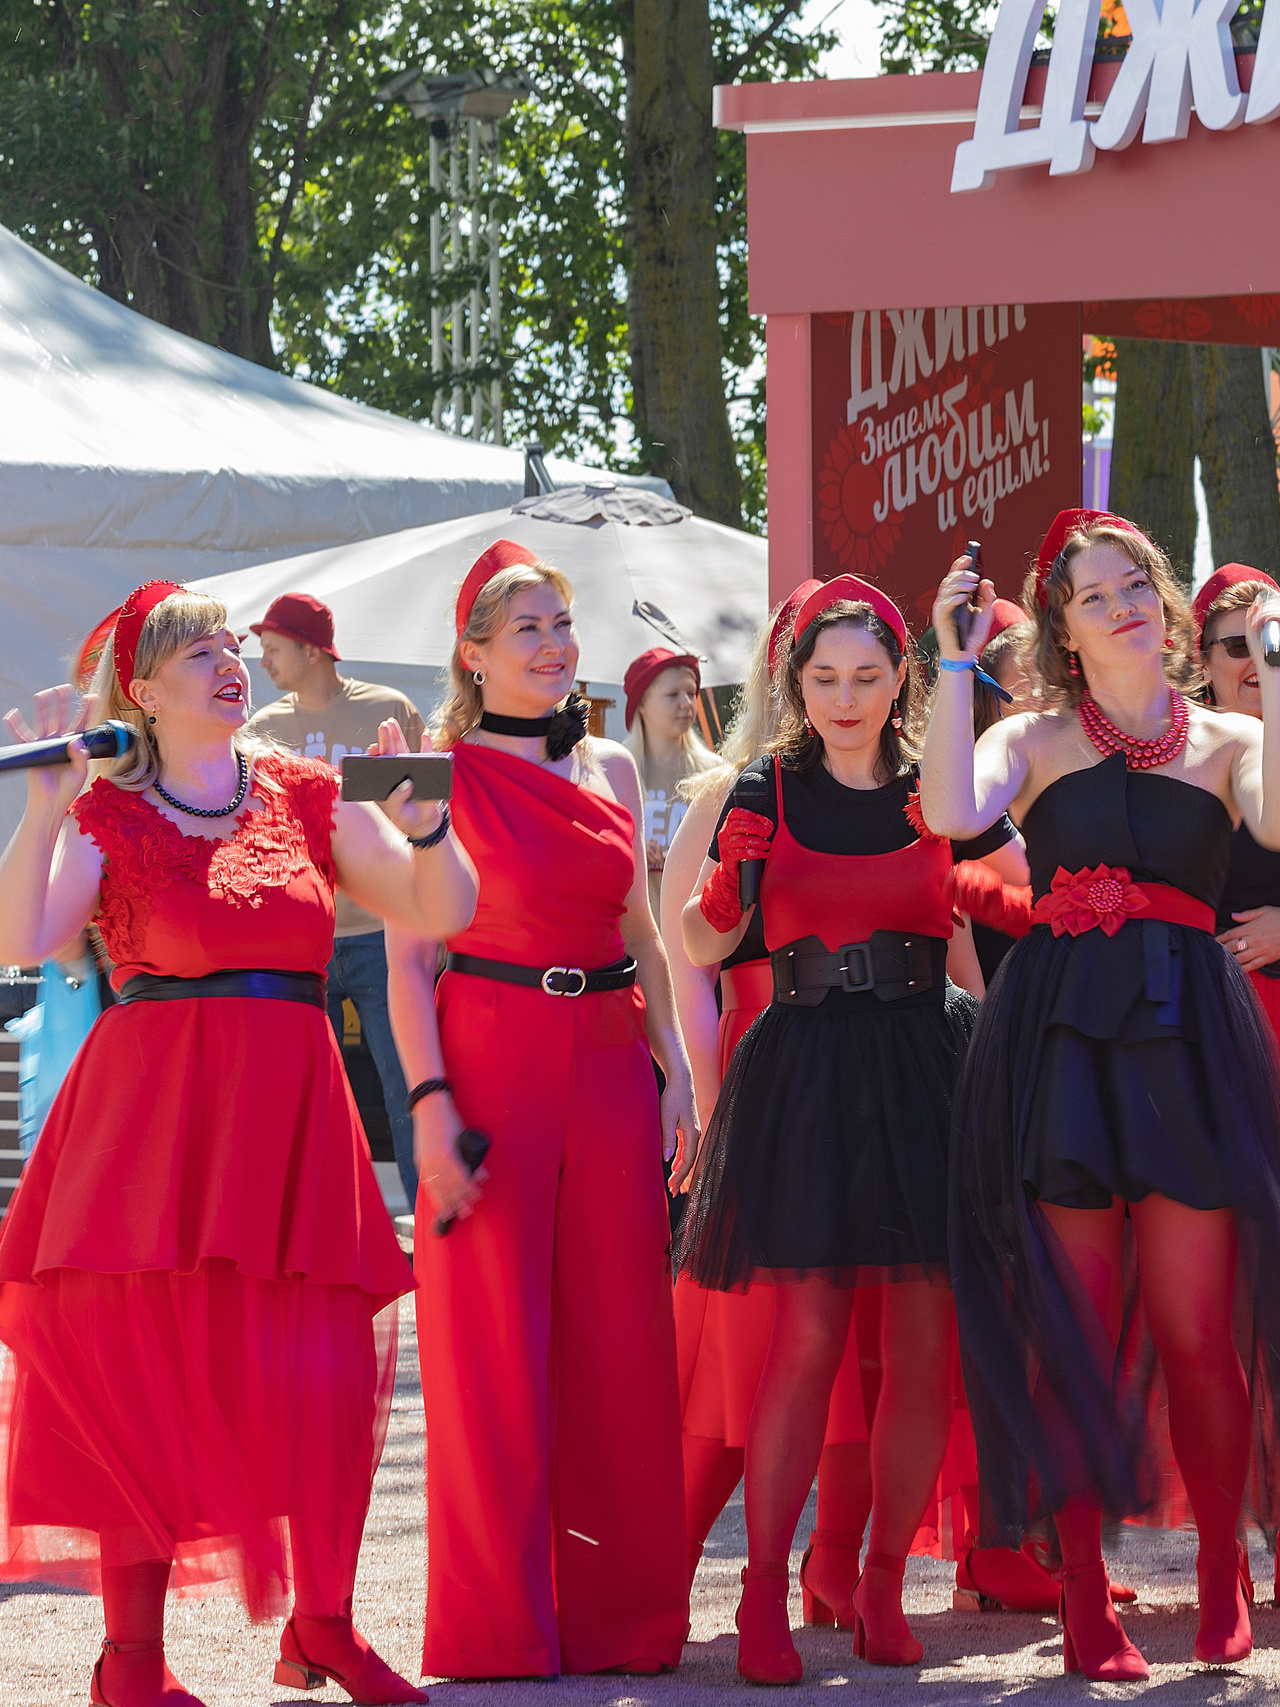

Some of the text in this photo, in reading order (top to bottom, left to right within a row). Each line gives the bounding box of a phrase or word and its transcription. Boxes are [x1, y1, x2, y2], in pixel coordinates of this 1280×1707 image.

[860, 393, 948, 465] Знаем,
[873, 374, 1039, 522] любим
[962, 418, 1051, 529] едим!
